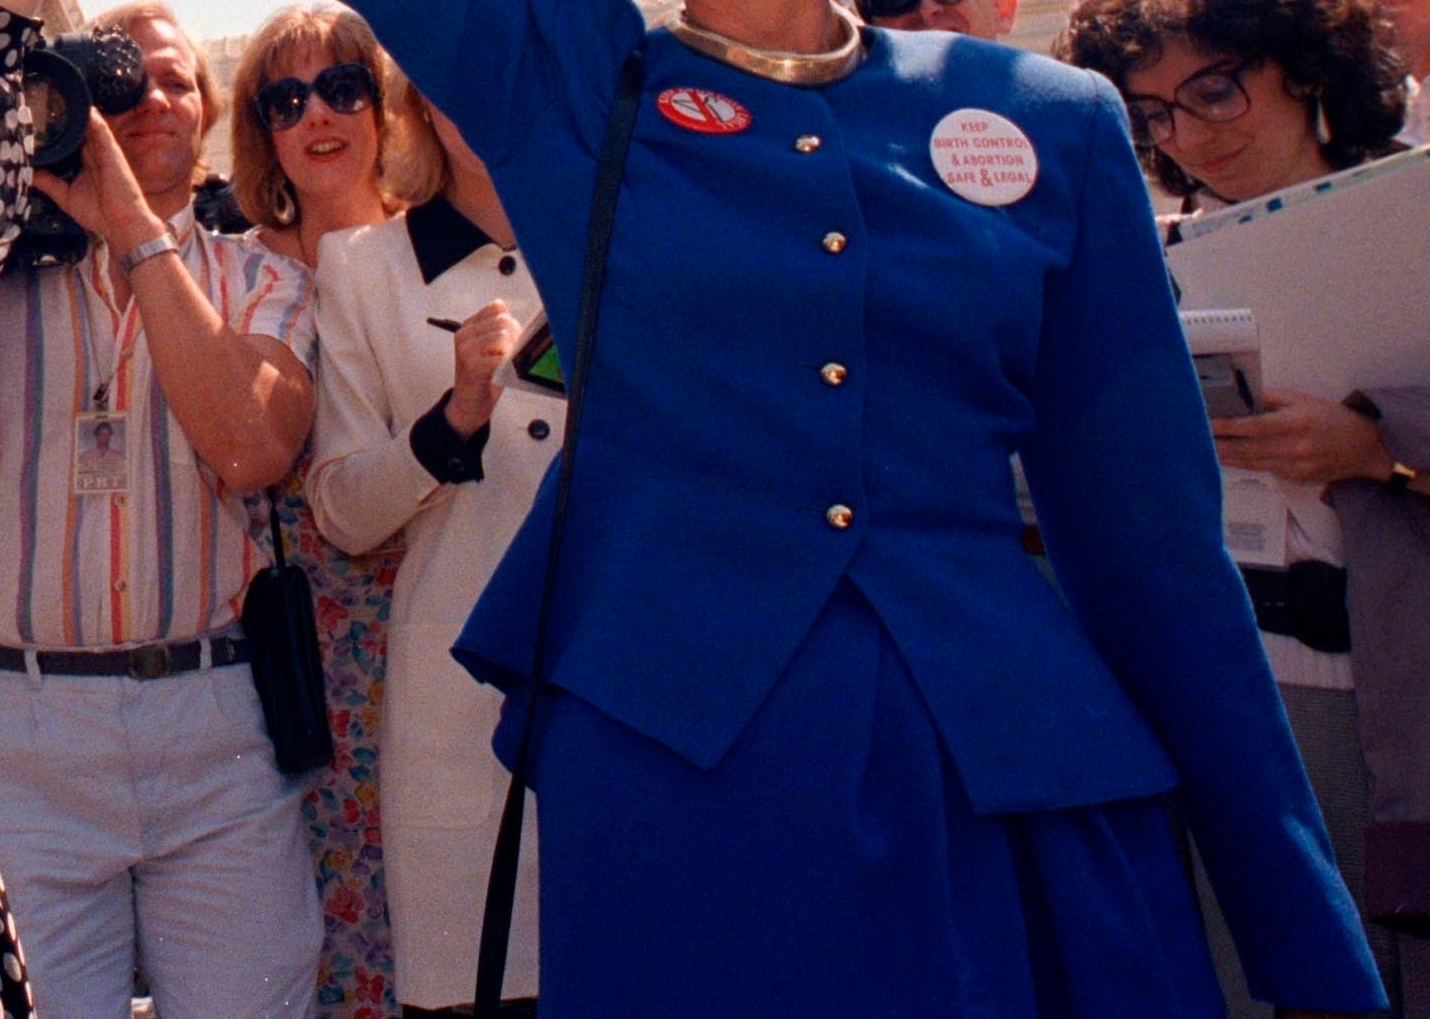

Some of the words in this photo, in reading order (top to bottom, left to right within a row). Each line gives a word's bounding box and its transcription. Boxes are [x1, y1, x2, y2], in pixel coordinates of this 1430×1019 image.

[961, 122, 987, 132] KEEP
[934, 138, 968, 149] BIRTH
[973, 138, 1029, 149] CONTROL
[951, 154, 960, 166] &
[963, 155, 1023, 166] ABORTION
[948, 172, 976, 184] SAFE
[980, 168, 993, 187] &
[994, 172, 1033, 183] LEGAL
